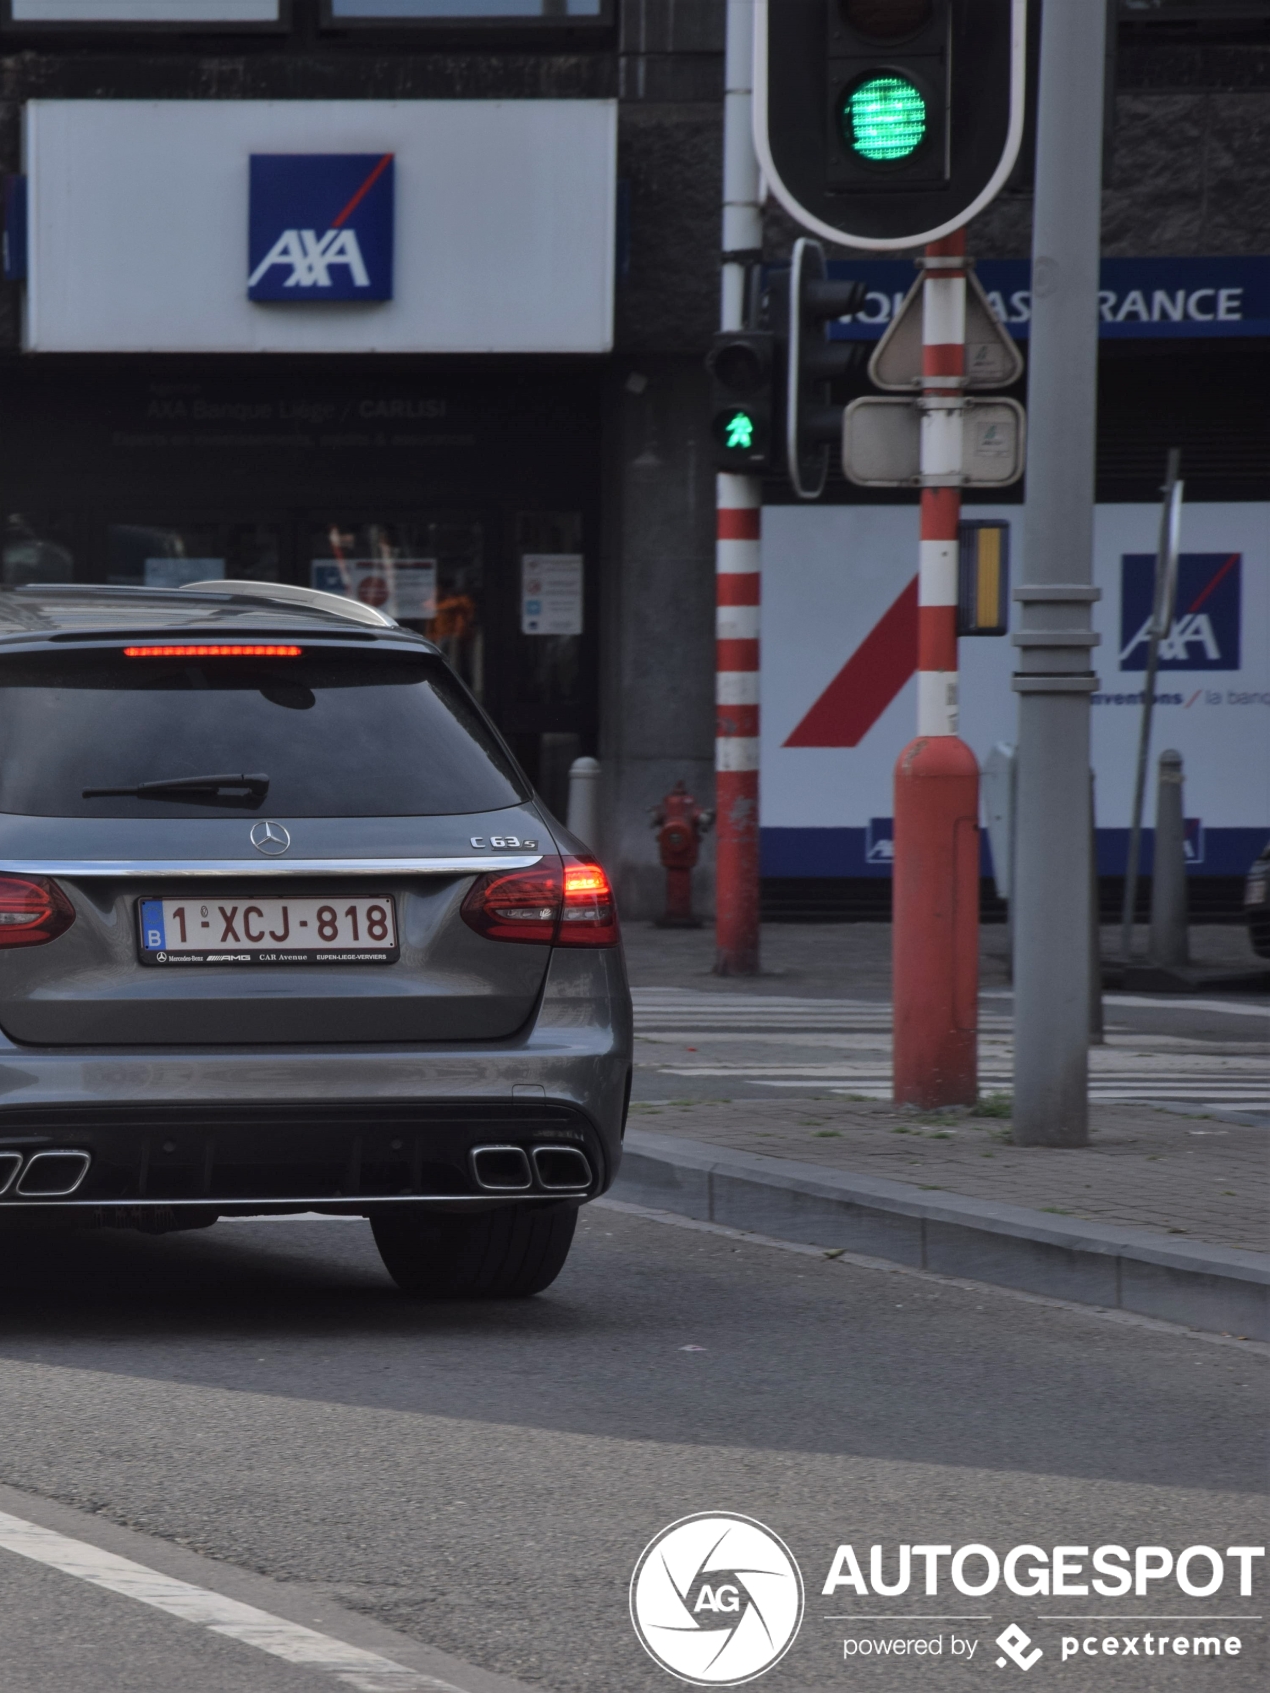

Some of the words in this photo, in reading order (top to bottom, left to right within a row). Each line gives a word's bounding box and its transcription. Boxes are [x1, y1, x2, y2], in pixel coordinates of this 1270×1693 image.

[248, 227, 370, 288] AXA
[986, 288, 1244, 323] ASRANCE
[1120, 612, 1222, 661] AXA
[148, 930, 162, 947] B
[168, 954, 204, 962] Mercedes-Benz
[259, 953, 277, 961] CAR
[278, 953, 308, 961] Avenue
